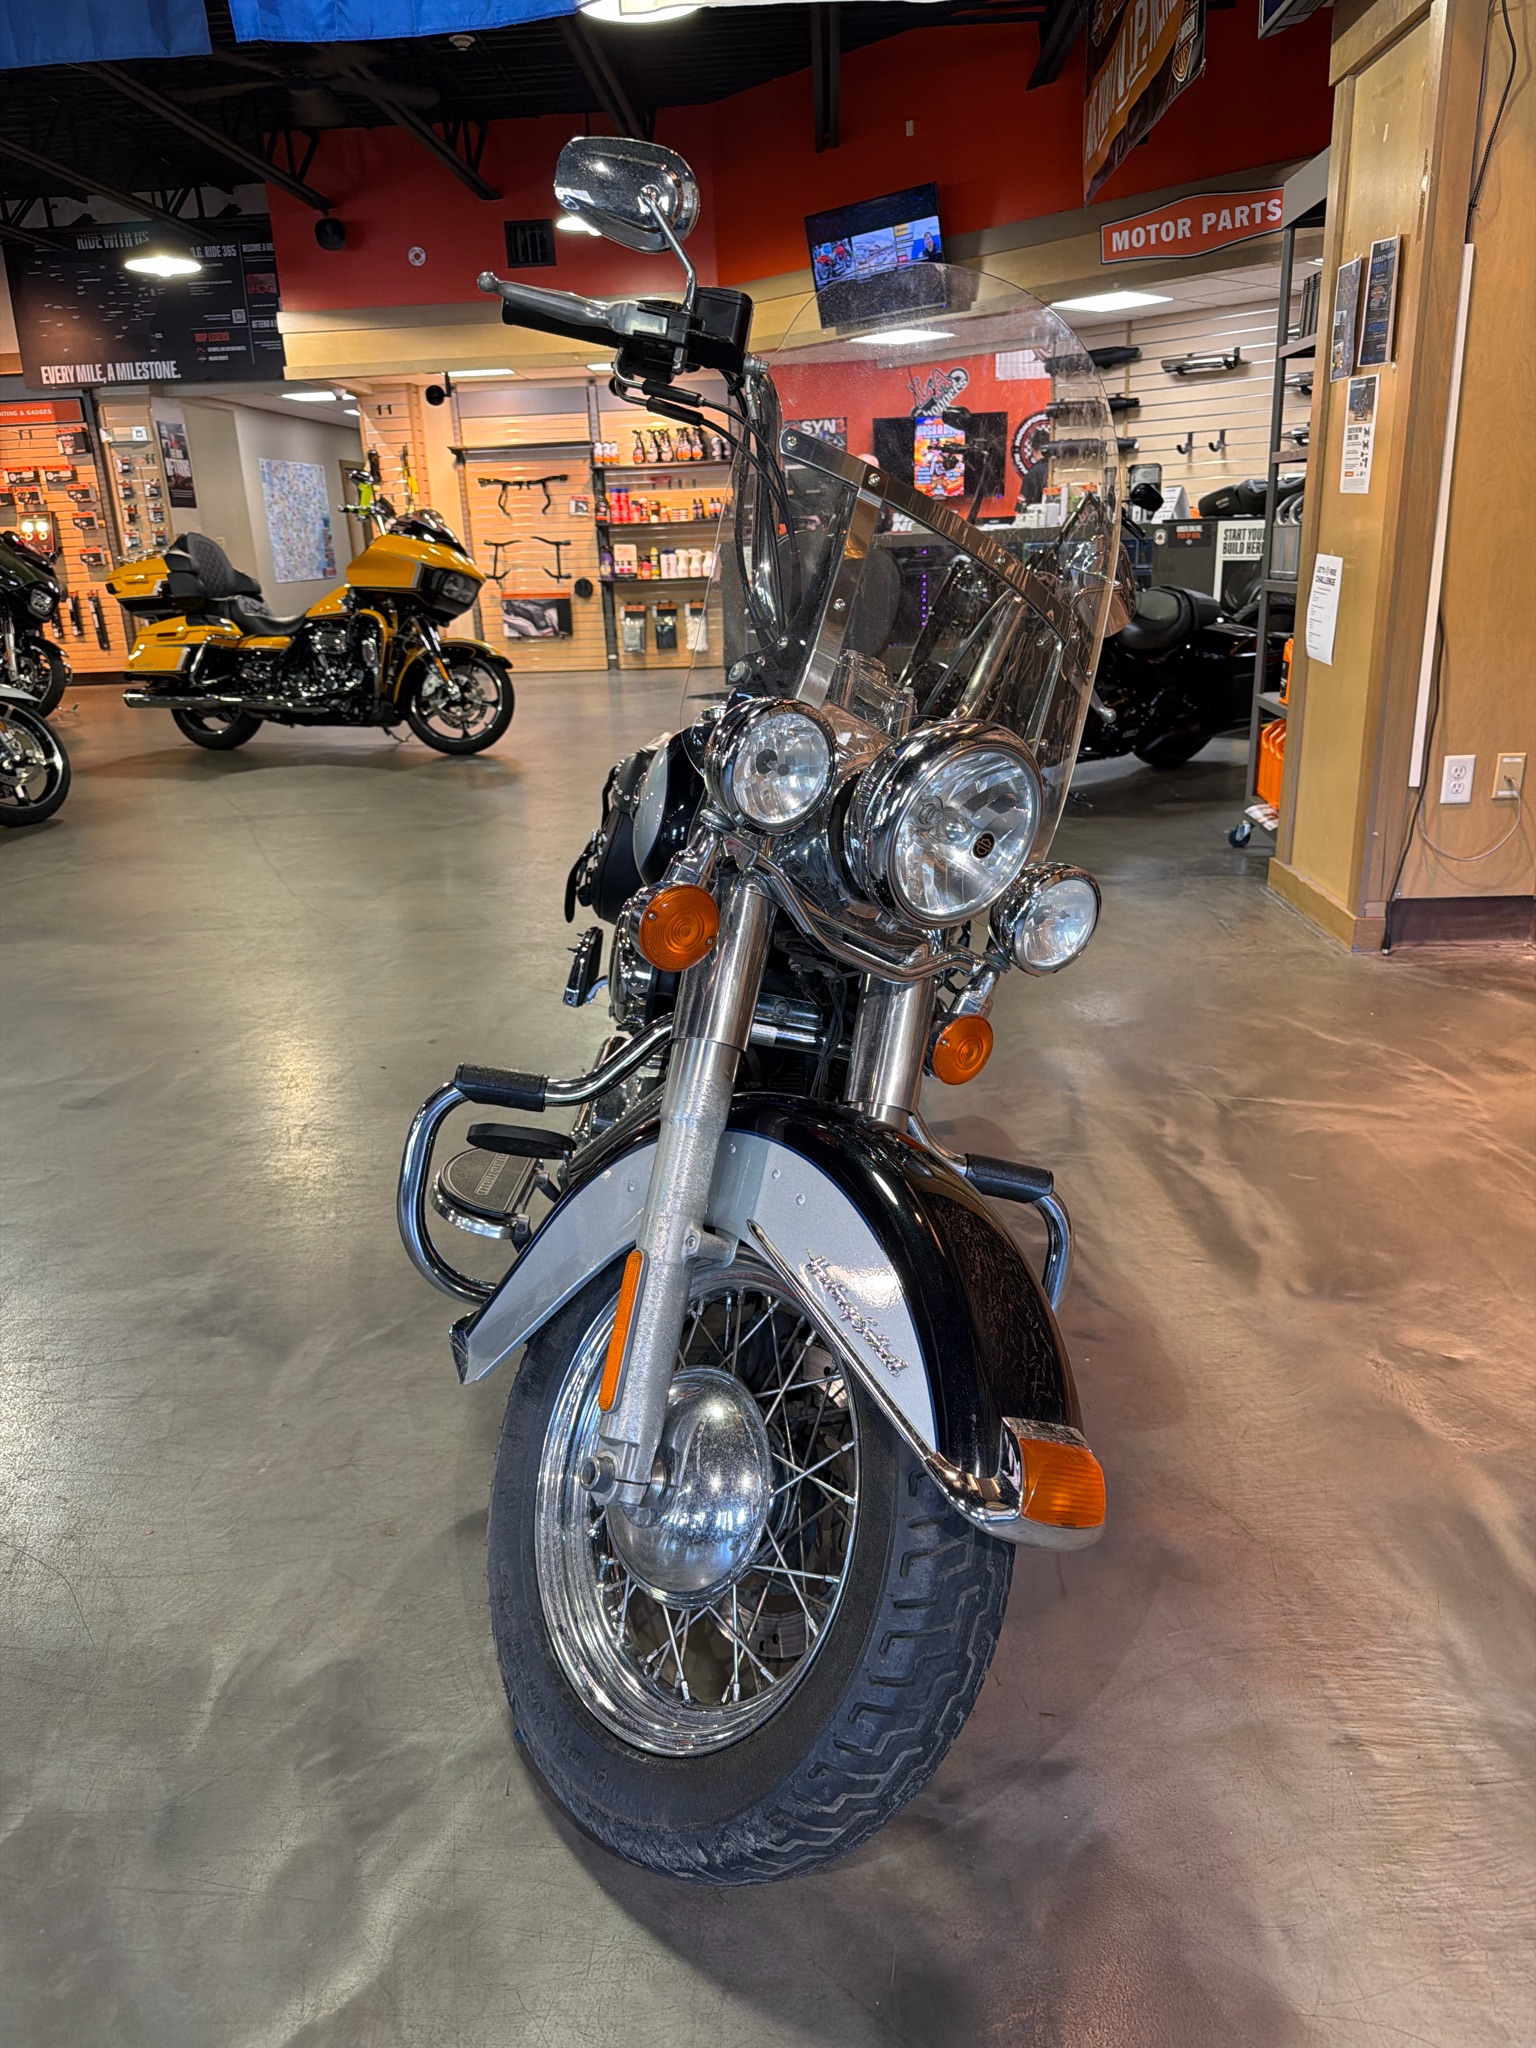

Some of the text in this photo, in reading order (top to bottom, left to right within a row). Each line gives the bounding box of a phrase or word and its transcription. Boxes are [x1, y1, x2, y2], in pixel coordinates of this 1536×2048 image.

[1112, 198, 1282, 252] MOTOR PARTS
[204, 245, 221, 258] RIDE
[221, 244, 237, 257] 365
[40, 360, 182, 384] EVERY MILE, A MILESTONE.
[26, 408, 53, 416] GAUGES
[1223, 528, 1247, 541] START
[1222, 542, 1244, 555] BUILD
